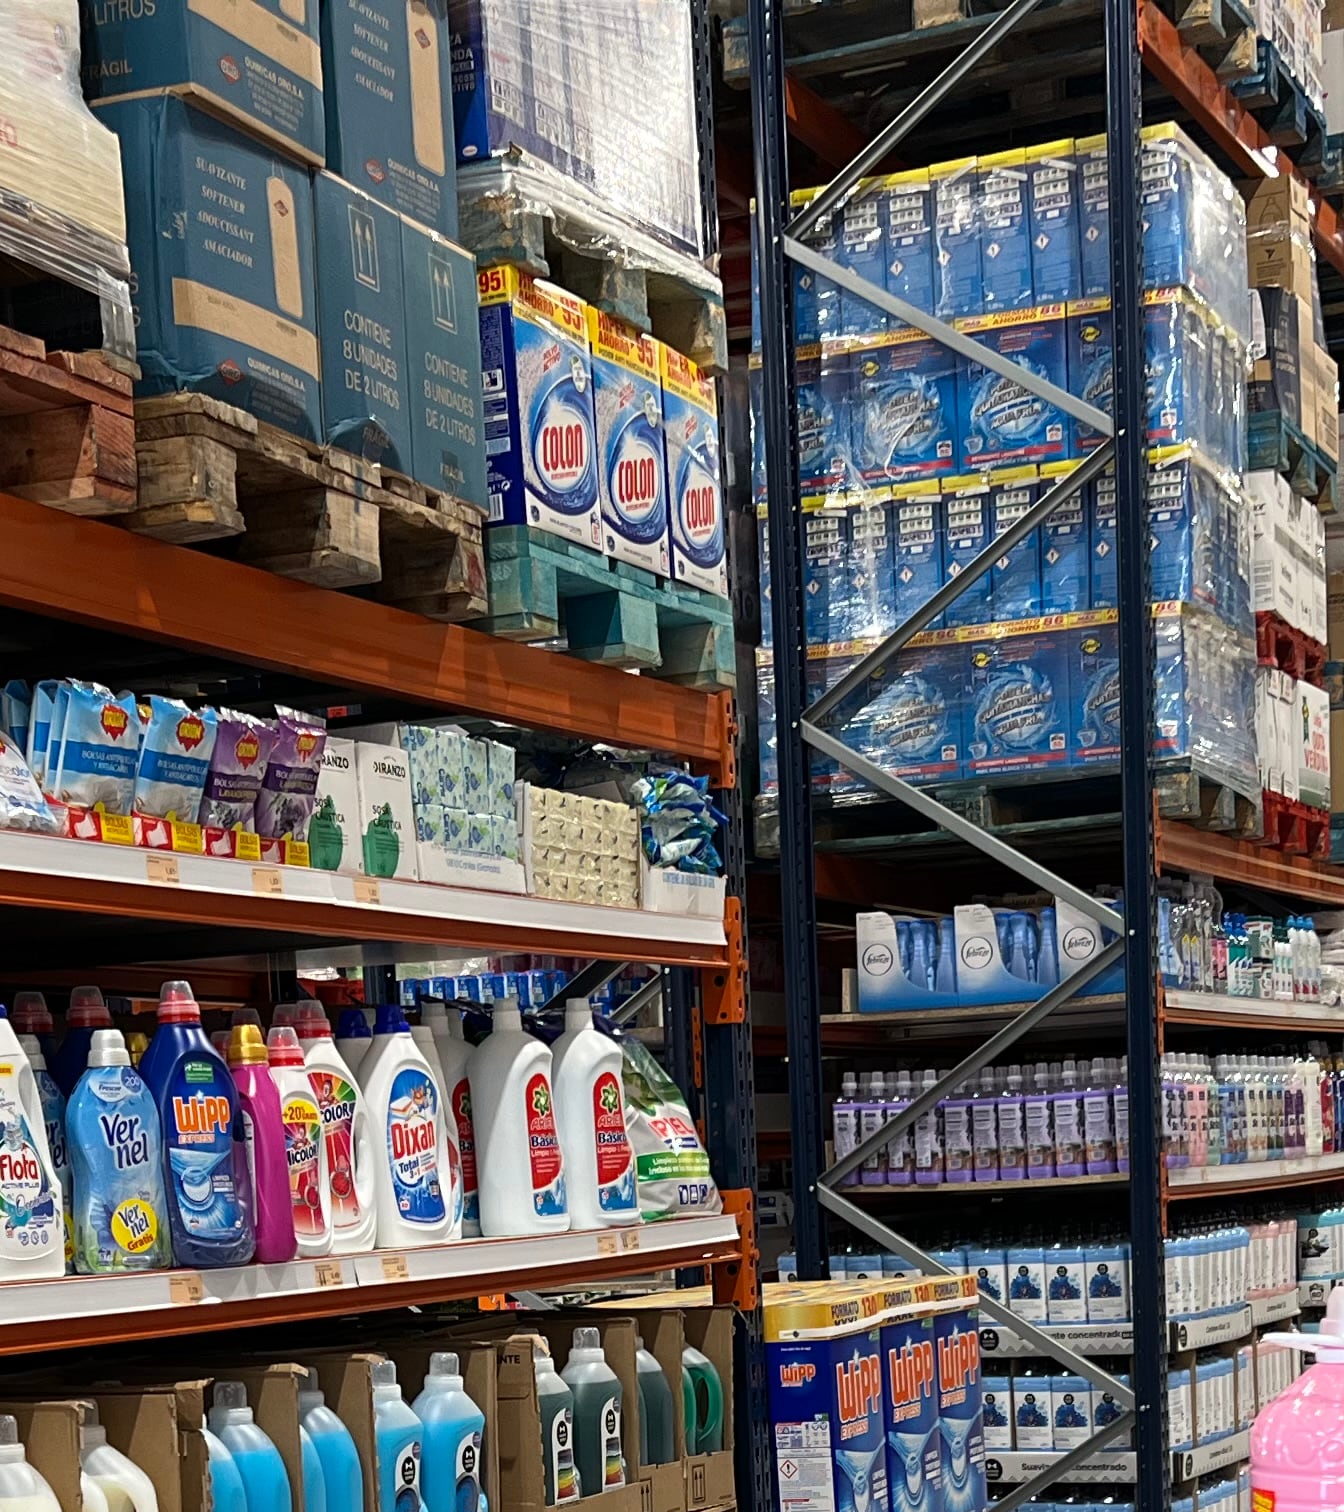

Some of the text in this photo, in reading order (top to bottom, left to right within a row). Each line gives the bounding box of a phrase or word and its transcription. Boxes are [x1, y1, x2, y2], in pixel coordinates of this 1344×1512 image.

[196, 156, 247, 191] SUAVIZANTE
[201, 185, 246, 215] SOFTENER
[344, 309, 391, 349] CONTIENE
[353, 342, 398, 382] UNIDADES
[345, 368, 400, 410] DE 2 LITROS
[542, 423, 584, 472] COLON
[618, 457, 655, 504] COLON
[686, 486, 715, 529] COLON
[101, 1114, 138, 1148] Ver
[117, 1133, 149, 1169] nel
[391, 1119, 436, 1159] Dixan
[398, 1158, 420, 1175] Total
[127, 1233, 154, 1251] Gratis
